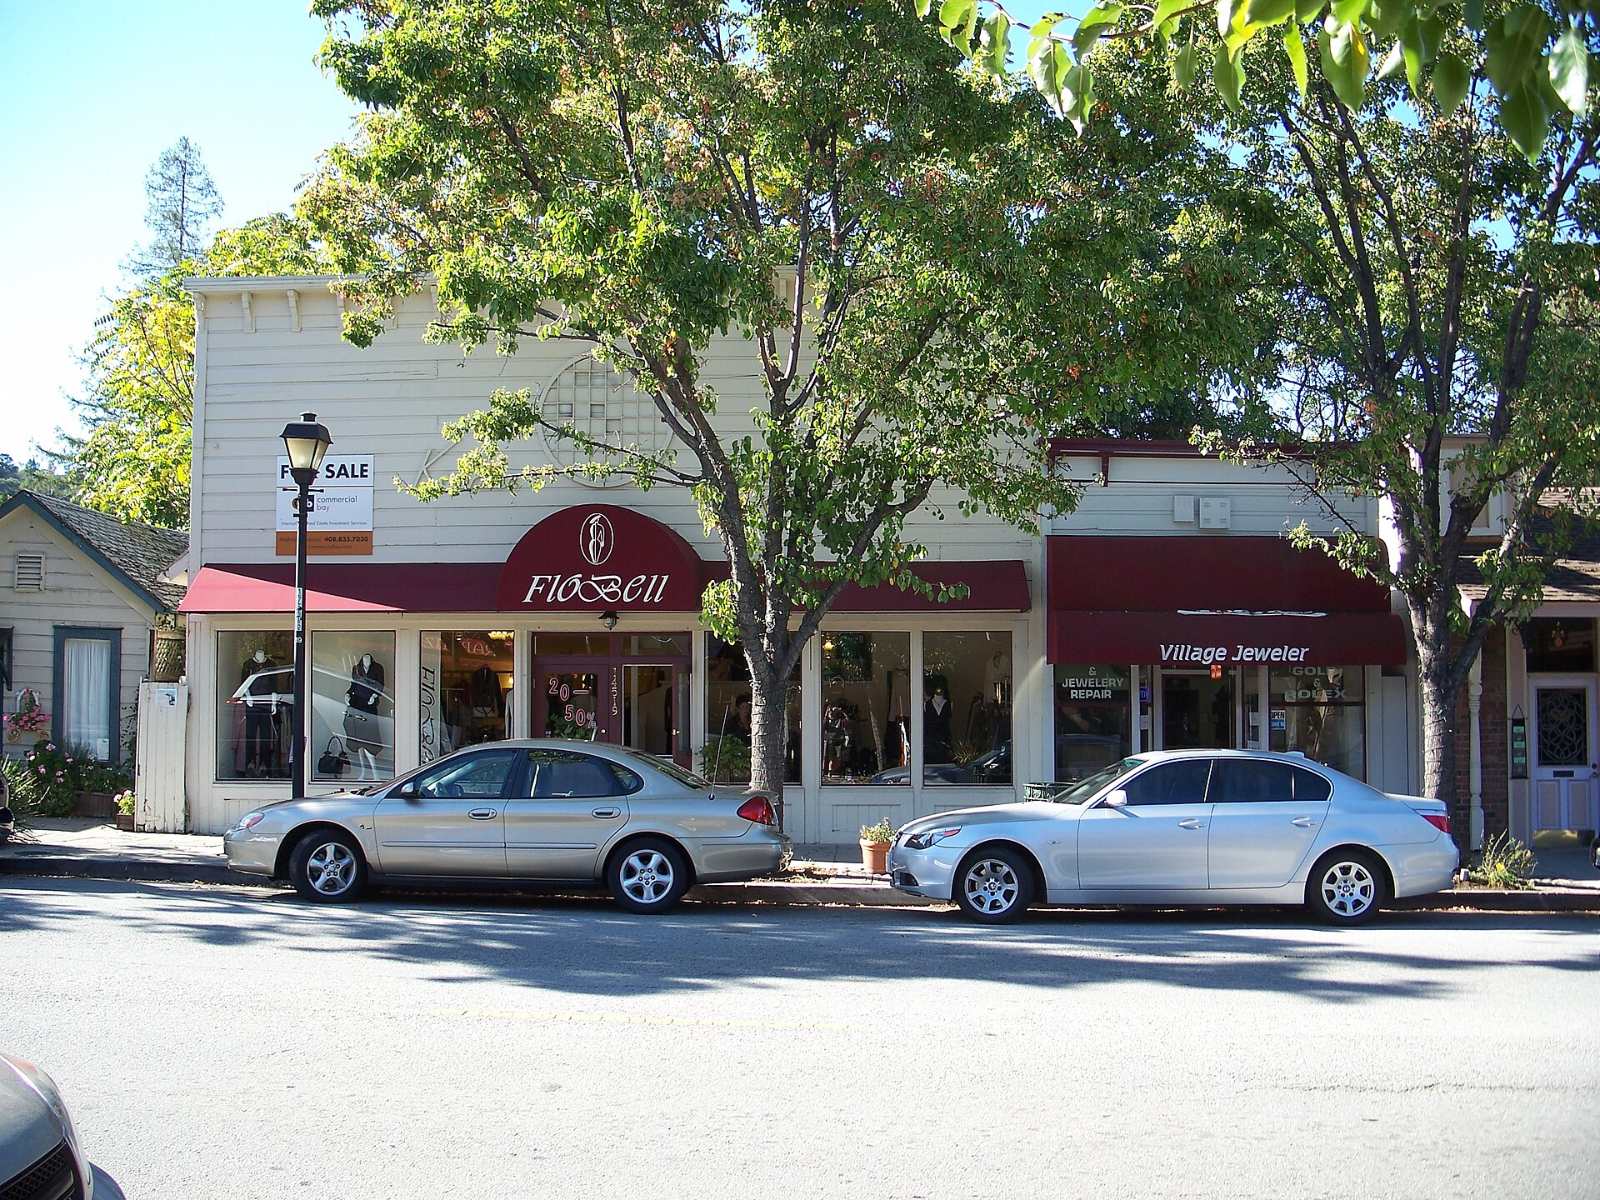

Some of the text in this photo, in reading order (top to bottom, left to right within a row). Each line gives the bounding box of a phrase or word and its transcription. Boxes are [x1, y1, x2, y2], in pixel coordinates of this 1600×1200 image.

[325, 463, 369, 479] SALE
[317, 495, 358, 503] commercial
[316, 504, 330, 512] bay
[1160, 644, 1309, 665] Village Jeweler
[1088, 666, 1097, 676] &
[1062, 678, 1124, 688] JEWELERY
[1070, 689, 1112, 699] REPAIR
